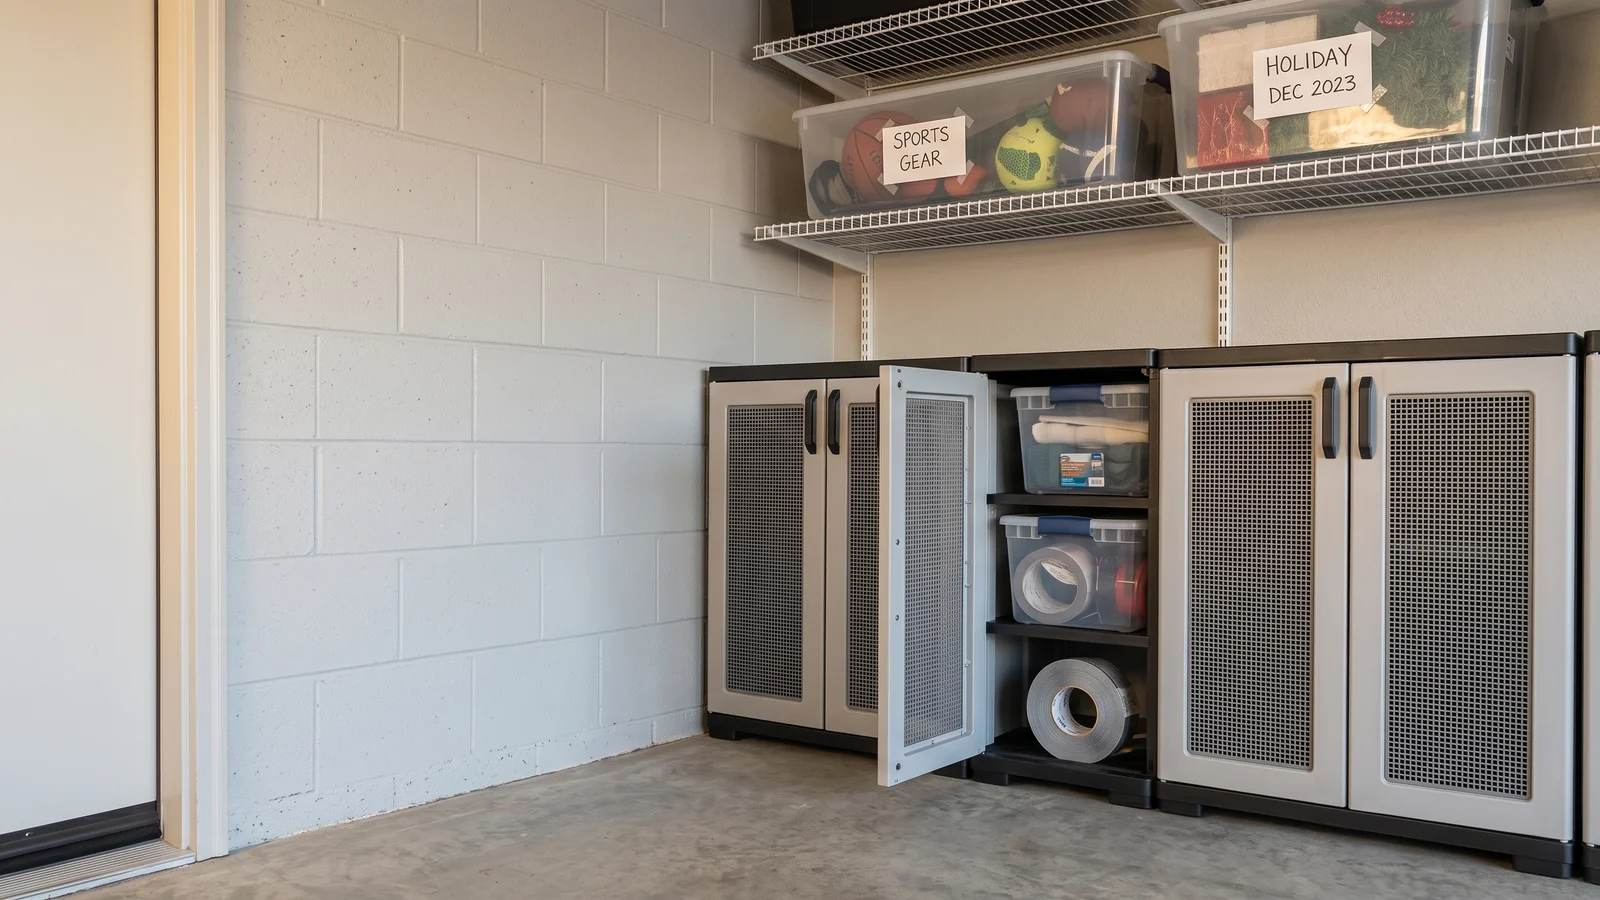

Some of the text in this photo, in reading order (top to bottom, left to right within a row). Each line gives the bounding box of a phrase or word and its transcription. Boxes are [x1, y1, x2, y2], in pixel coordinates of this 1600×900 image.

[1266, 44, 1353, 76] HOLIDAY
[1268, 75, 1357, 105] DEC 2023
[893, 126, 950, 149] SPORTS
[899, 149, 943, 172] GEAR
